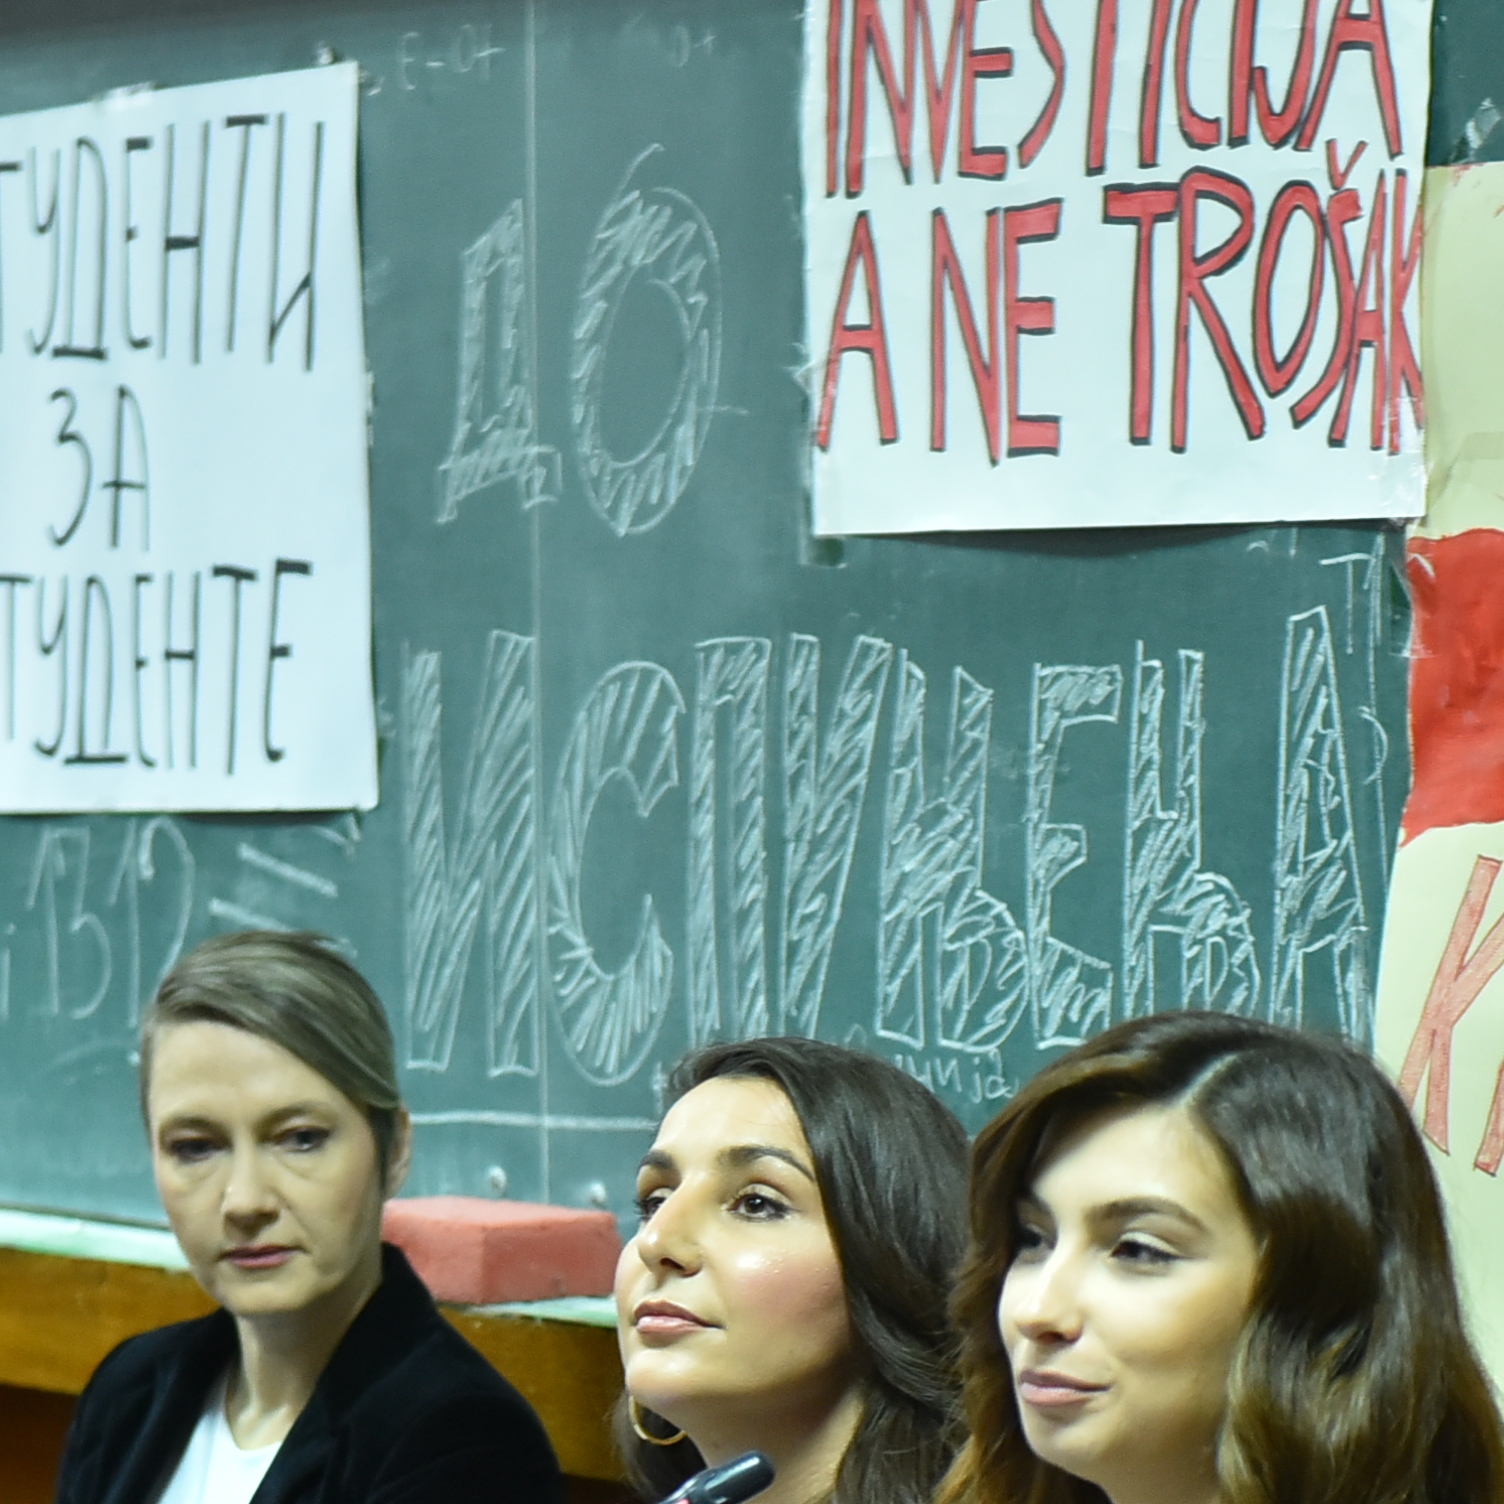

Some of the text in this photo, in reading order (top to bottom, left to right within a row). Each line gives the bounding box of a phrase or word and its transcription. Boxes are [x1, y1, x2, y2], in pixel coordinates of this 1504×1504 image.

[814, 140, 1426, 466] A NE TROŠAK
[46, 384, 152, 553] ЗА
